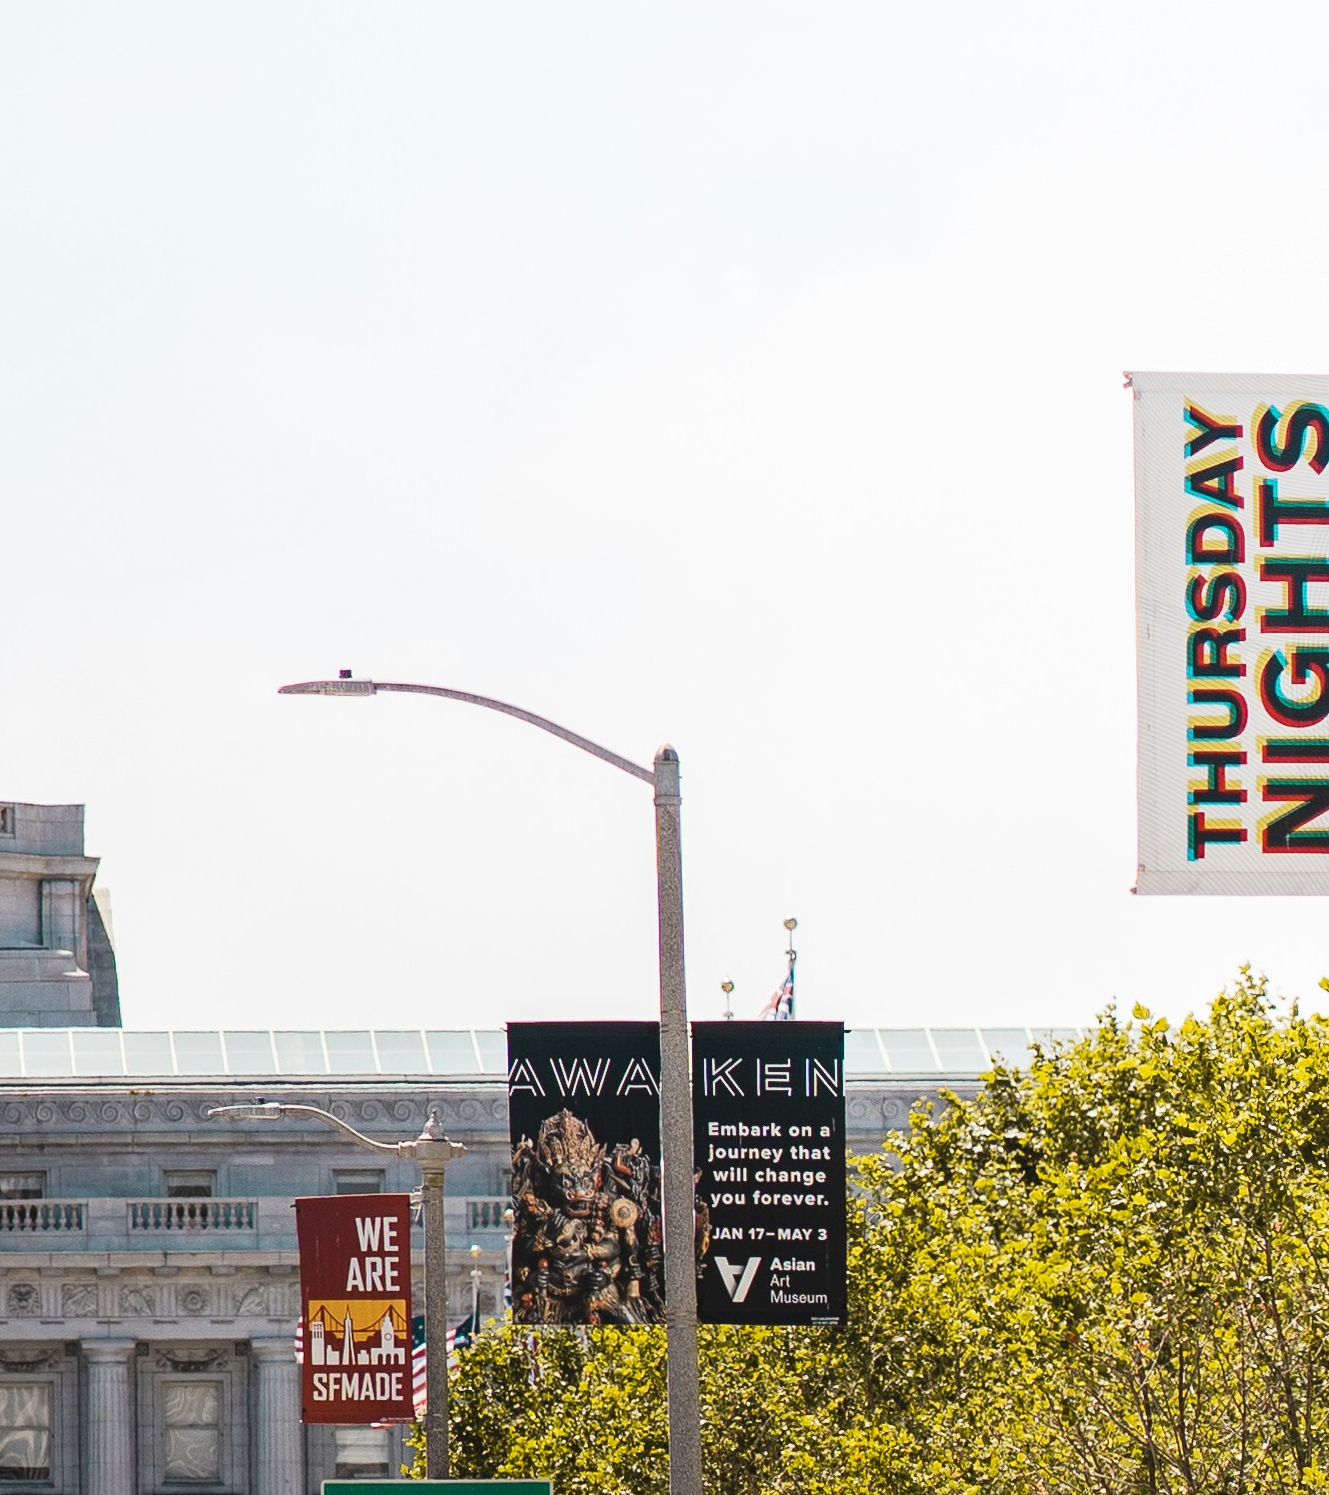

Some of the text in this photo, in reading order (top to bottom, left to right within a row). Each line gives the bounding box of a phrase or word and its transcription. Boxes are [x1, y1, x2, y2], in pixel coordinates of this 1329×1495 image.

[1183, 394, 1247, 861] THURSDAY
[1252, 398, 1329, 855] NIGHTS
[708, 1122, 831, 1137] Embark on a
[708, 1144, 831, 1163] journey that
[713, 1167, 827, 1186] will change
[710, 1190, 829, 1208] you forever.
[355, 1216, 399, 1252] WE
[712, 1227, 743, 1240] JAN
[817, 1229, 828, 1241] 3
[770, 1257, 816, 1271] Asian
[345, 1256, 401, 1292] ARE
[770, 1274, 791, 1287] Art
[770, 1290, 828, 1304] Museum
[313, 1372, 404, 1401] SFMADE
